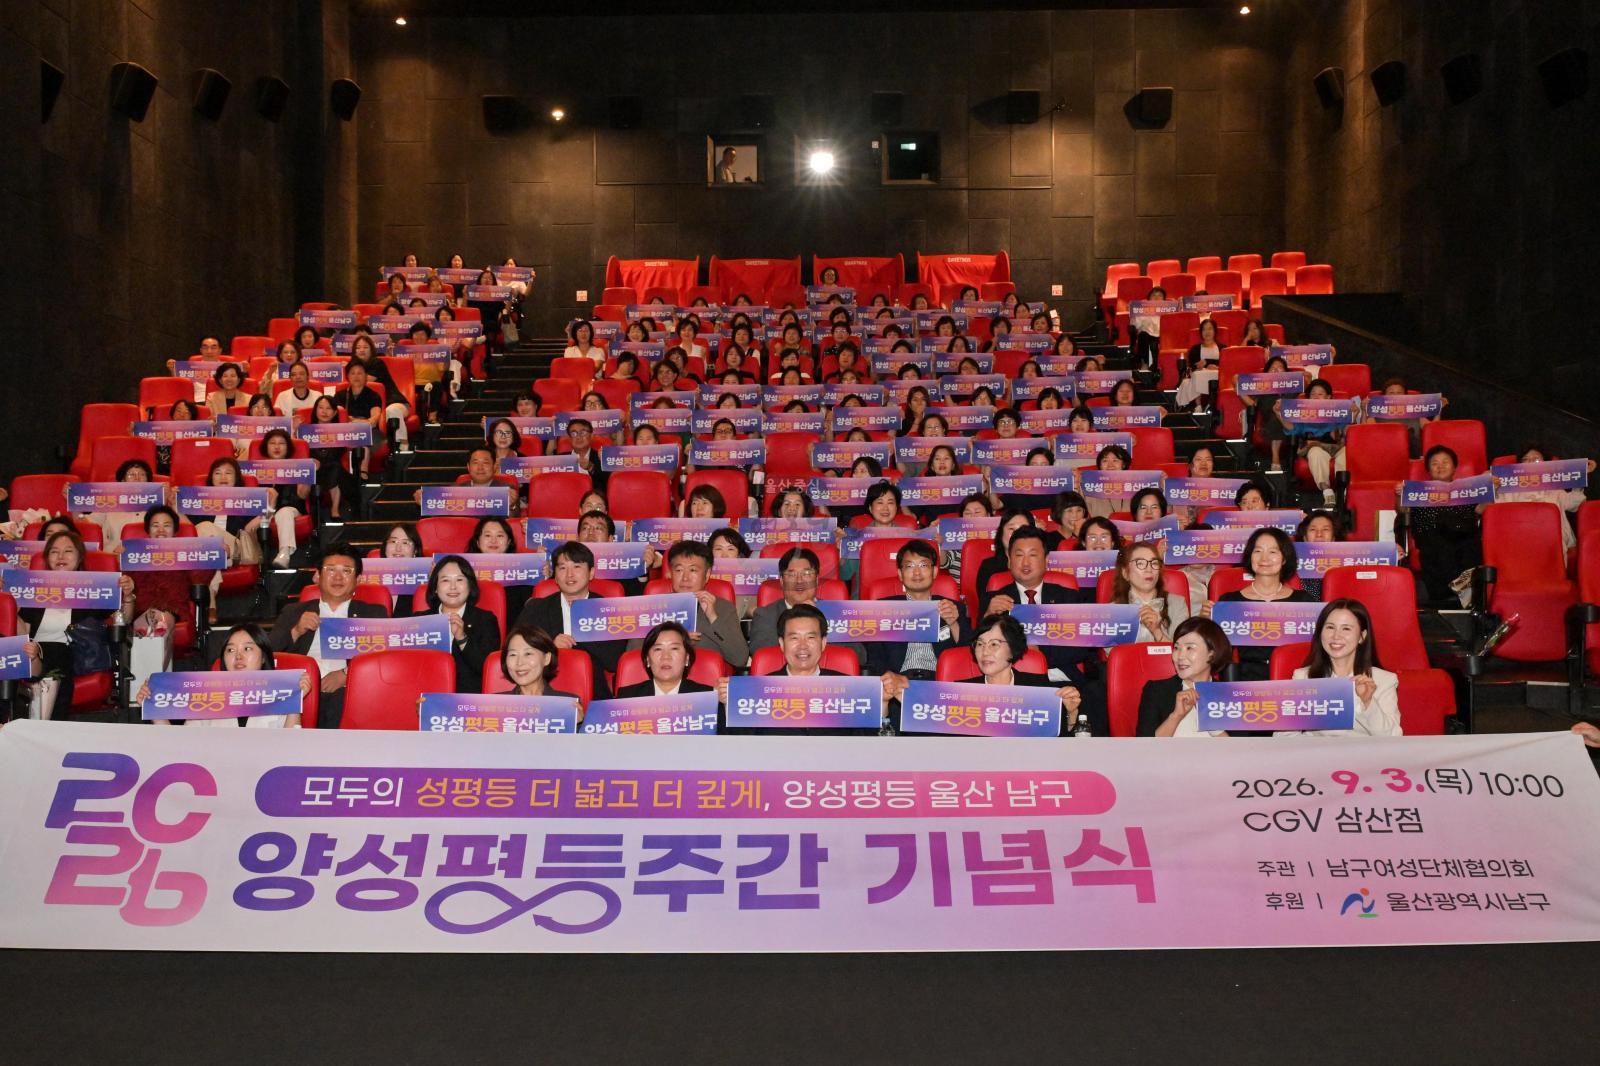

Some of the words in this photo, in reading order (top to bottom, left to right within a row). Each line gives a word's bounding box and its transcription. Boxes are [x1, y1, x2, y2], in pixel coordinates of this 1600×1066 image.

[793, 420, 822, 430] 울산남구
[869, 415, 898, 425] 울산남구
[960, 413, 993, 424] 울산남구
[1126, 414, 1156, 425] 울산남구
[606, 455, 641, 467] 양성평등
[643, 454, 674, 466] 울산남구
[694, 449, 728, 461] 양성평등
[729, 449, 761, 460] 울산남구
[276, 468, 310, 478] 울산남구
[1499, 476, 1540, 487] 양성평등
[1541, 472, 1581, 484] 울산남구
[995, 477, 1032, 490] 양성평등
[1033, 478, 1068, 489] 울산남구
[1084, 481, 1123, 494] 양성평등
[73, 495, 117, 508] 양성평등
[118, 494, 158, 505] 울산남구
[851, 488, 868, 498] 울산
[901, 488, 940, 501] 양성평등
[941, 486, 977, 497] 울산남구
[1169, 488, 1209, 501] 양성평등
[1210, 487, 1237, 499] 울산남
[1408, 491, 1450, 503] 양성평등
[1450, 486, 1488, 499] 울산남구
[181, 497, 222, 510] 양성평등
[224, 499, 262, 510] 울산남구
[426, 499, 464, 511] 양성평등
[466, 498, 503, 509] 울산남구
[637, 530, 680, 546] 양성평등
[682, 530, 711, 542] 울산남
[744, 530, 788, 546] 양성평등
[789, 530, 831, 542] 울산남구
[128, 551, 175, 566] 양성평등
[177, 550, 219, 562] 울산남구
[1172, 542, 1221, 559] 양성평등
[1223, 542, 1245, 554] 울산
[597, 558, 640, 570] 울산남구
[493, 569, 540, 582] 울산남구
[9, 586, 61, 602] 양성평등
[64, 586, 113, 600] 울산남구
[578, 614, 637, 634] 양성평등
[879, 616, 931, 631] 울산남구
[1079, 621, 1132, 636] 울산남구
[1220, 619, 1281, 640] 양성평등
[1283, 620, 1318, 636] 울산
[327, 635, 386, 652] 양성평등
[388, 632, 442, 648] 울산남구
[154, 690, 225, 712] 양성평등
[228, 689, 292, 705] 울산남구
[737, 698, 806, 721] 양성평등
[808, 698, 871, 714] 울산남구
[912, 703, 981, 728] 양성평등
[984, 706, 1049, 726] 울산남구
[1207, 700, 1279, 723] 양성평등
[1281, 698, 1345, 717] 울산남구
[501, 716, 566, 733] 울산남구
[656, 713, 718, 733] 울산남구
[1232, 777, 1324, 799] 2026.
[1331, 769, 1373, 795] 9.
[1479, 771, 1565, 798] 10:00
[300, 776, 403, 808] 모두의
[417, 778, 516, 808] 성평등
[530, 779, 561, 808] 더
[575, 779, 638, 808] 넓고
[653, 779, 683, 809] 더
[697, 780, 770, 812] 깊게,
[782, 779, 915, 808] 양성평등
[928, 778, 996, 808] 울산
[1006, 777, 1074, 808] 남구
[1242, 807, 1323, 833] CGV
[1335, 806, 1424, 834] 삼산점
[1257, 860, 1297, 878] 주관
[1326, 858, 1535, 879] 남구여성단체협의회
[233, 831, 830, 934] 양성평등주간
[865, 826, 1157, 906] 기념식
[1265, 892, 1305, 911] 후원
[1386, 892, 1552, 912] 울산광역시남구
